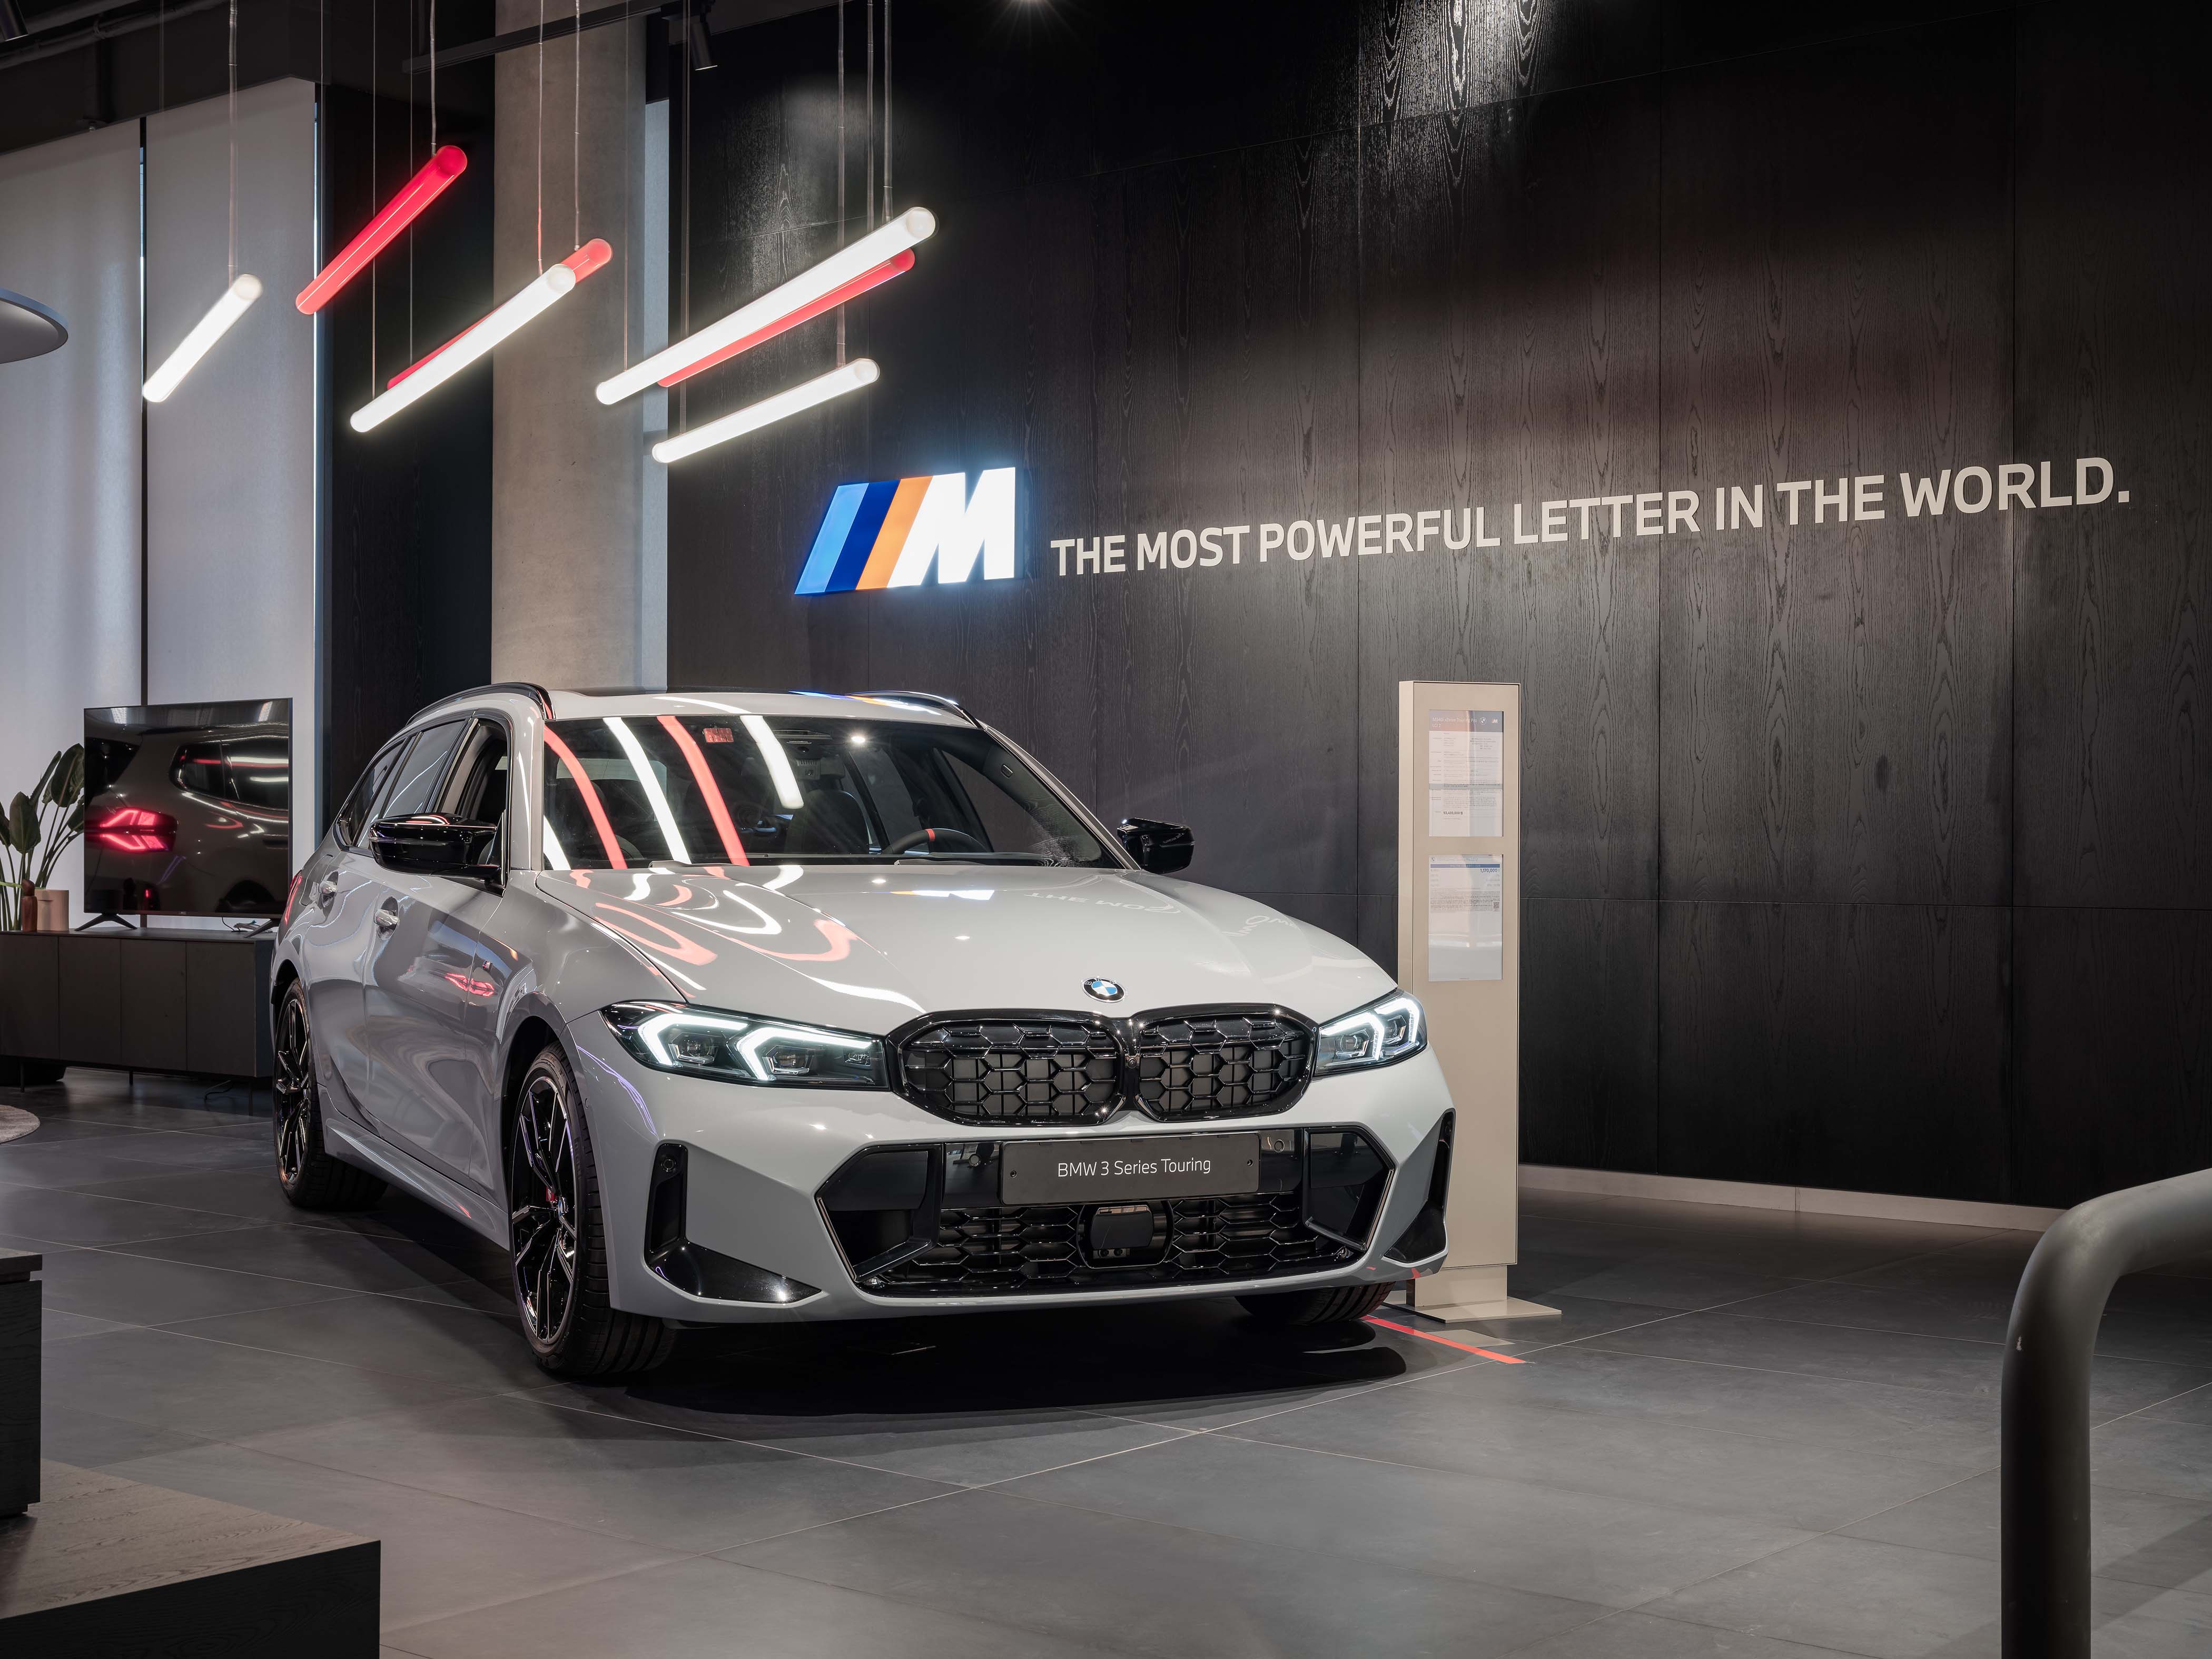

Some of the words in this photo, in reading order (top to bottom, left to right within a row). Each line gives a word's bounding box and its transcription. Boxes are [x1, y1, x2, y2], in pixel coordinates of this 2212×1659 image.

[1050, 535, 1126, 576] THE
[1137, 525, 1250, 571] MOST
[1260, 506, 1500, 562] POWERFUL
[1513, 490, 1701, 545] LETTER
[1716, 485, 1763, 530] IN
[1776, 475, 1885, 526] THE
[1900, 457, 2129, 517] WORLD.
[1058, 1162, 1097, 1177] BMW
[1101, 1161, 1109, 1176] 3
[1114, 1160, 1157, 1175] Series
[1160, 1157, 1211, 1174] Touring
